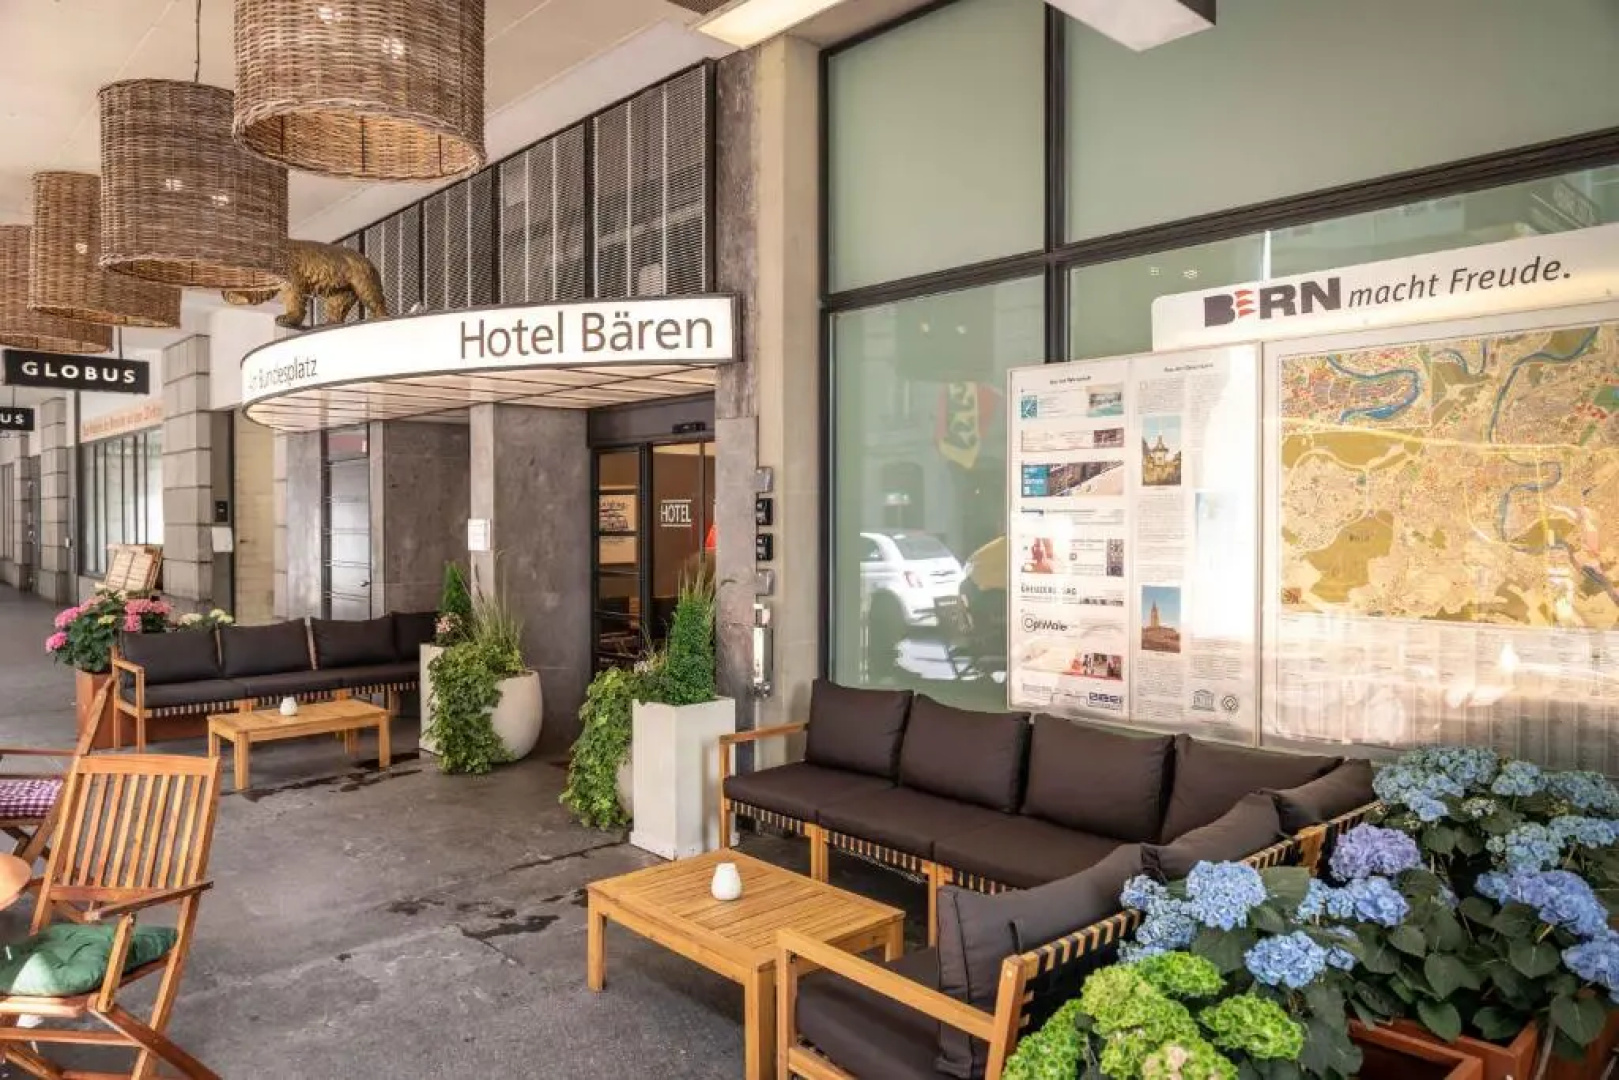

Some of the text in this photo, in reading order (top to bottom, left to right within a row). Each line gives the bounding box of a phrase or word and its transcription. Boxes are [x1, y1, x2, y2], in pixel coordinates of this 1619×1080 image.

[1204, 256, 1573, 328] BERN macht Freude.
[459, 310, 713, 360] Hotel Bären
[21, 361, 136, 383] GLOBUS
[660, 504, 692, 522] HOTEL
